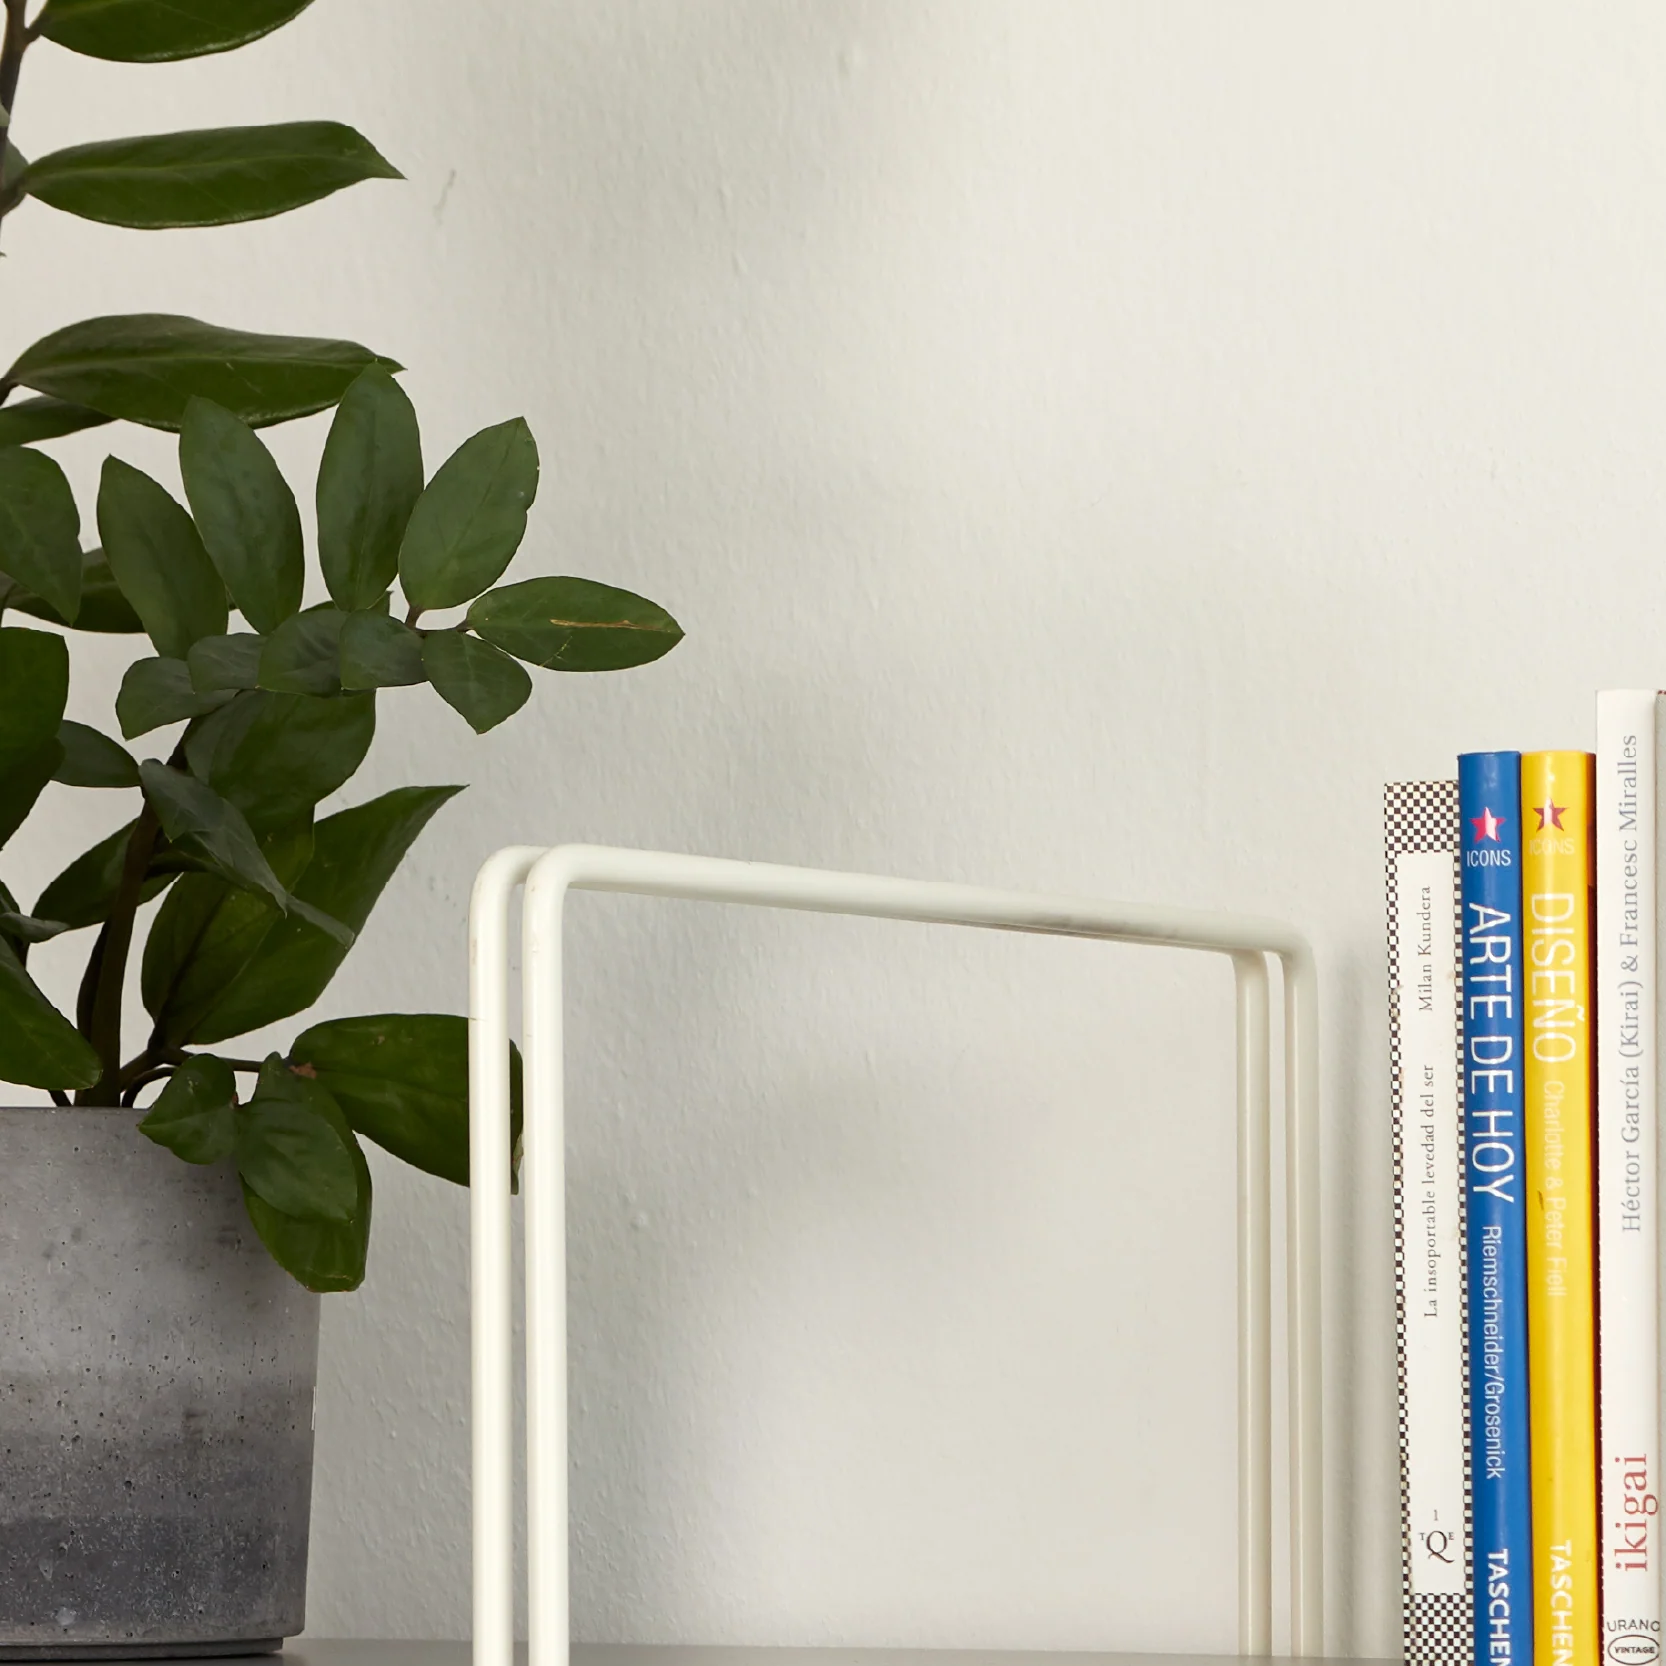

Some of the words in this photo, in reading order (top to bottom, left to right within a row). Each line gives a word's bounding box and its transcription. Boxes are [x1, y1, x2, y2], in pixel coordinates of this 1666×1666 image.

[1617, 735, 1637, 832] Miralles
[1466, 850, 1511, 867] ICONS
[1529, 838, 1575, 855] ICONS
[1416, 886, 1431, 956] Kundera
[1619, 840, 1638, 947] Francesc
[1418, 964, 1432, 1012] Milan
[1469, 902, 1512, 1020] ARTE
[1531, 893, 1586, 1063] DISEÑO
[1620, 955, 1639, 973] &
[1618, 980, 1643, 1058] (Kirai)
[1426, 1065, 1434, 1088] ser
[1471, 1036, 1514, 1094] DE
[1420, 1094, 1434, 1117] del
[1544, 1080, 1565, 1171] Charlotte
[1619, 1066, 1640, 1143] García
[1421, 1125, 1435, 1185] levedad
[1472, 1110, 1515, 1203] HOY
[1545, 1176, 1564, 1190] &
[1545, 1196, 1567, 1250] Peter
[1621, 1151, 1641, 1232] Héctor
[1422, 1191, 1442, 1293] insoportable
[1424, 1299, 1438, 1318] La
[1546, 1256, 1567, 1297] Fiell
[1482, 1225, 1506, 1480] Riemschneider/Grosenick
[1614, 1453, 1660, 1572] ikigai
[1614, 1646, 1656, 1654] VINTAGE
